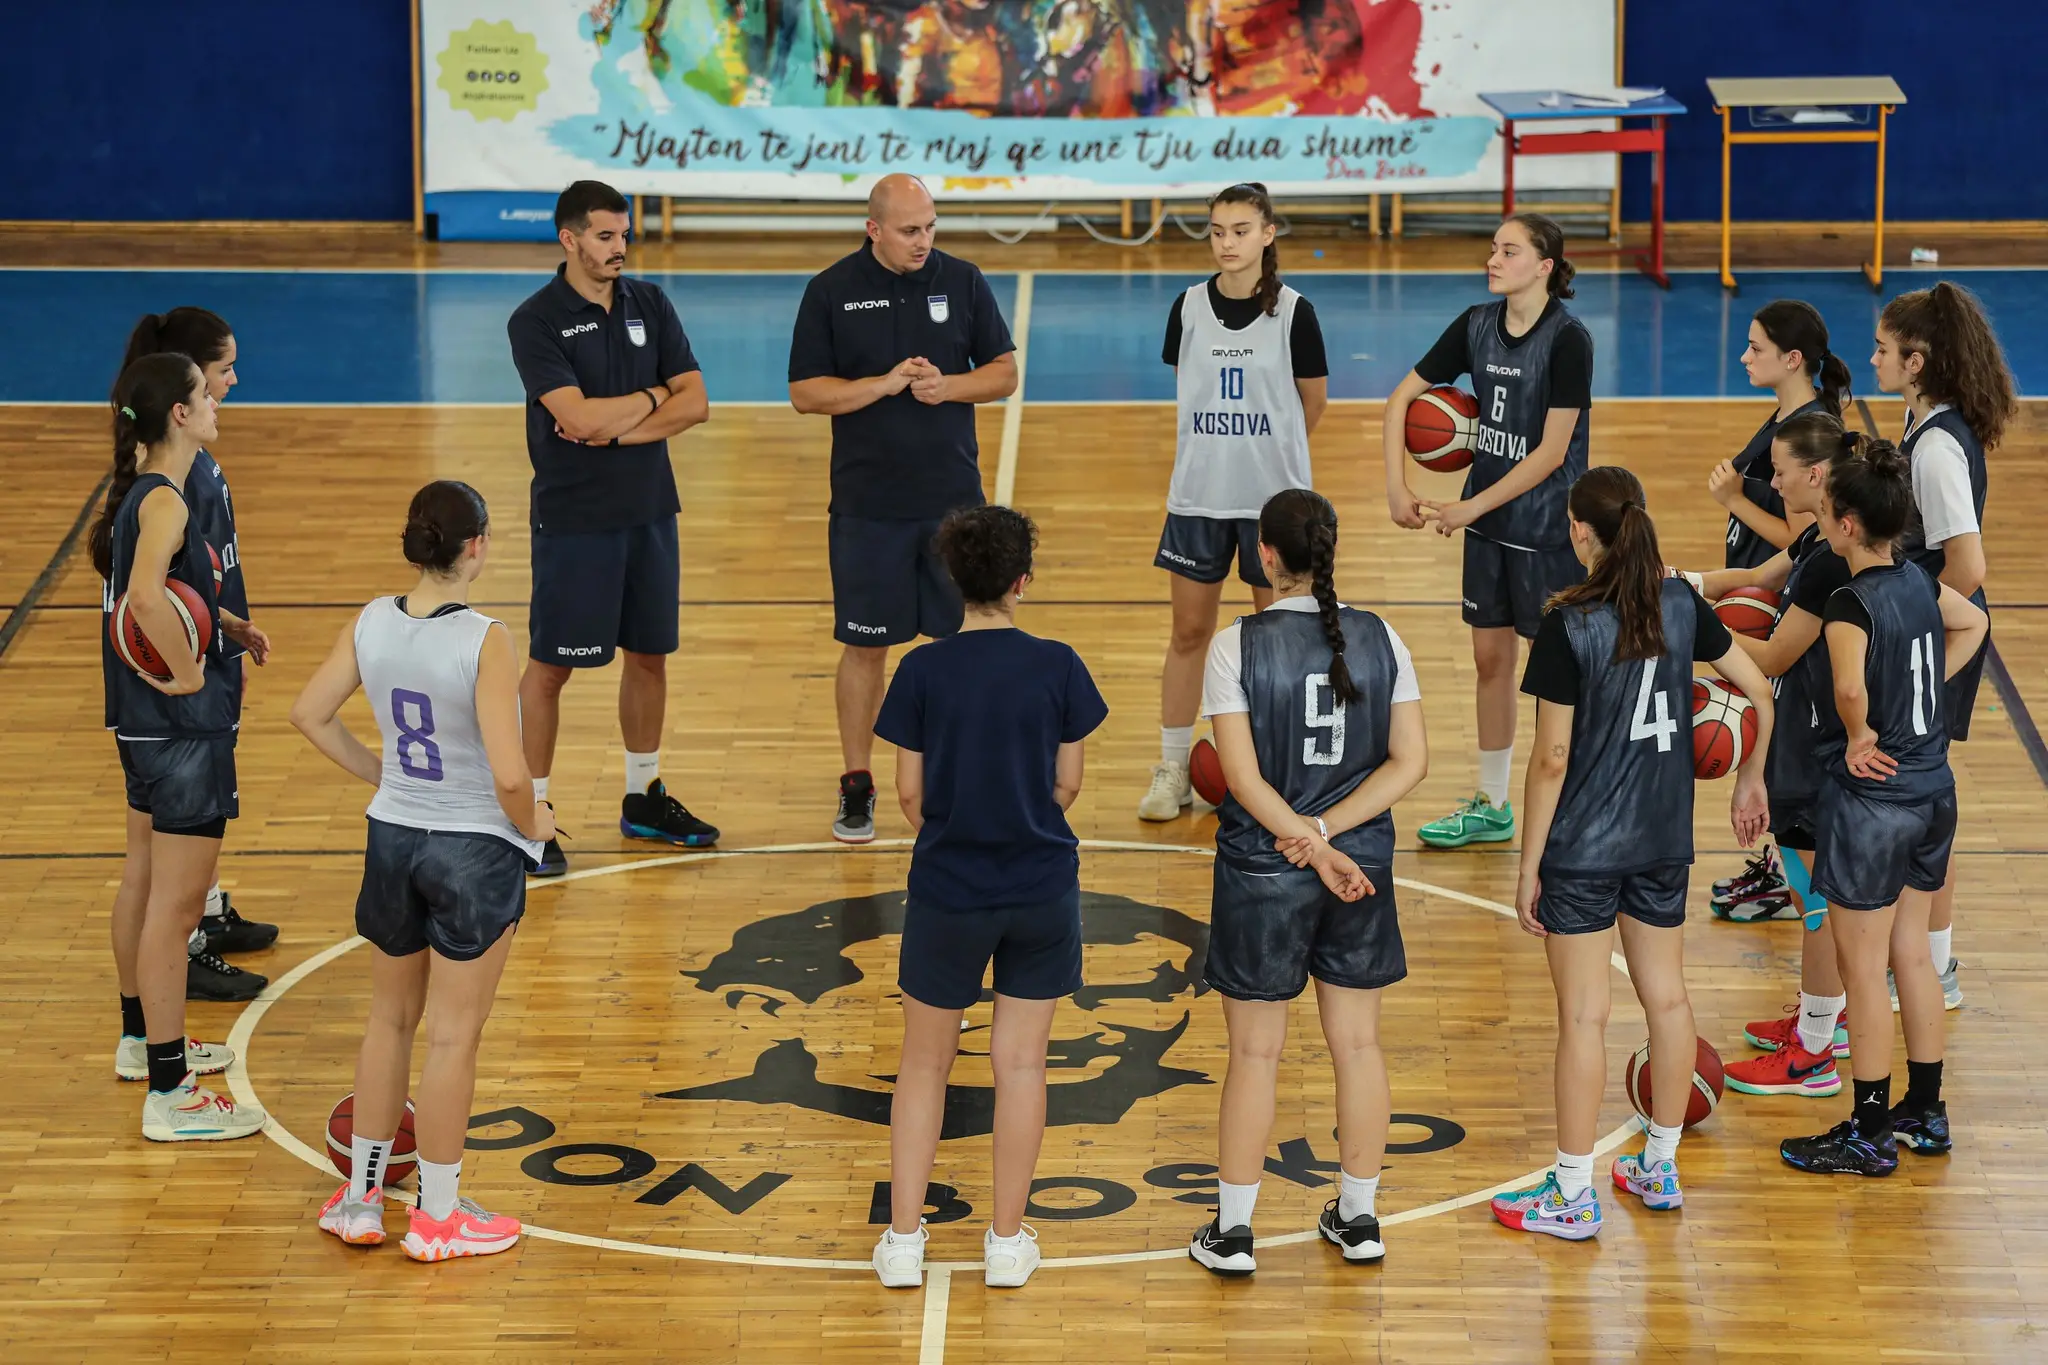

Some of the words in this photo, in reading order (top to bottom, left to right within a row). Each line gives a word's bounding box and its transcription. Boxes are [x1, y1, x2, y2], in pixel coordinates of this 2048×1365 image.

[1006, 137, 1051, 172] që
[1059, 135, 1127, 163] unë
[1212, 126, 1290, 162] dua
[843, 299, 890, 311] GIVOVA
[562, 322, 599, 338] GIVOVA
[1212, 349, 1253, 357] GIVOVA
[1220, 367, 1244, 400] 10
[1486, 363, 1521, 377] GIVOVA
[1491, 385, 1507, 423] 6
[1193, 412, 1272, 437] KOSOVA
[1477, 424, 1527, 461] OSOVA
[1160, 548, 1196, 567] GIVOVA
[847, 621, 887, 634] GIVOVA
[557, 645, 602, 656] GIVOVA
[1910, 631, 1936, 736] 11
[1303, 673, 1346, 766] 9
[1629, 655, 1678, 753] 4
[391, 687, 444, 782] 8
[463, 1105, 794, 1214] DON
